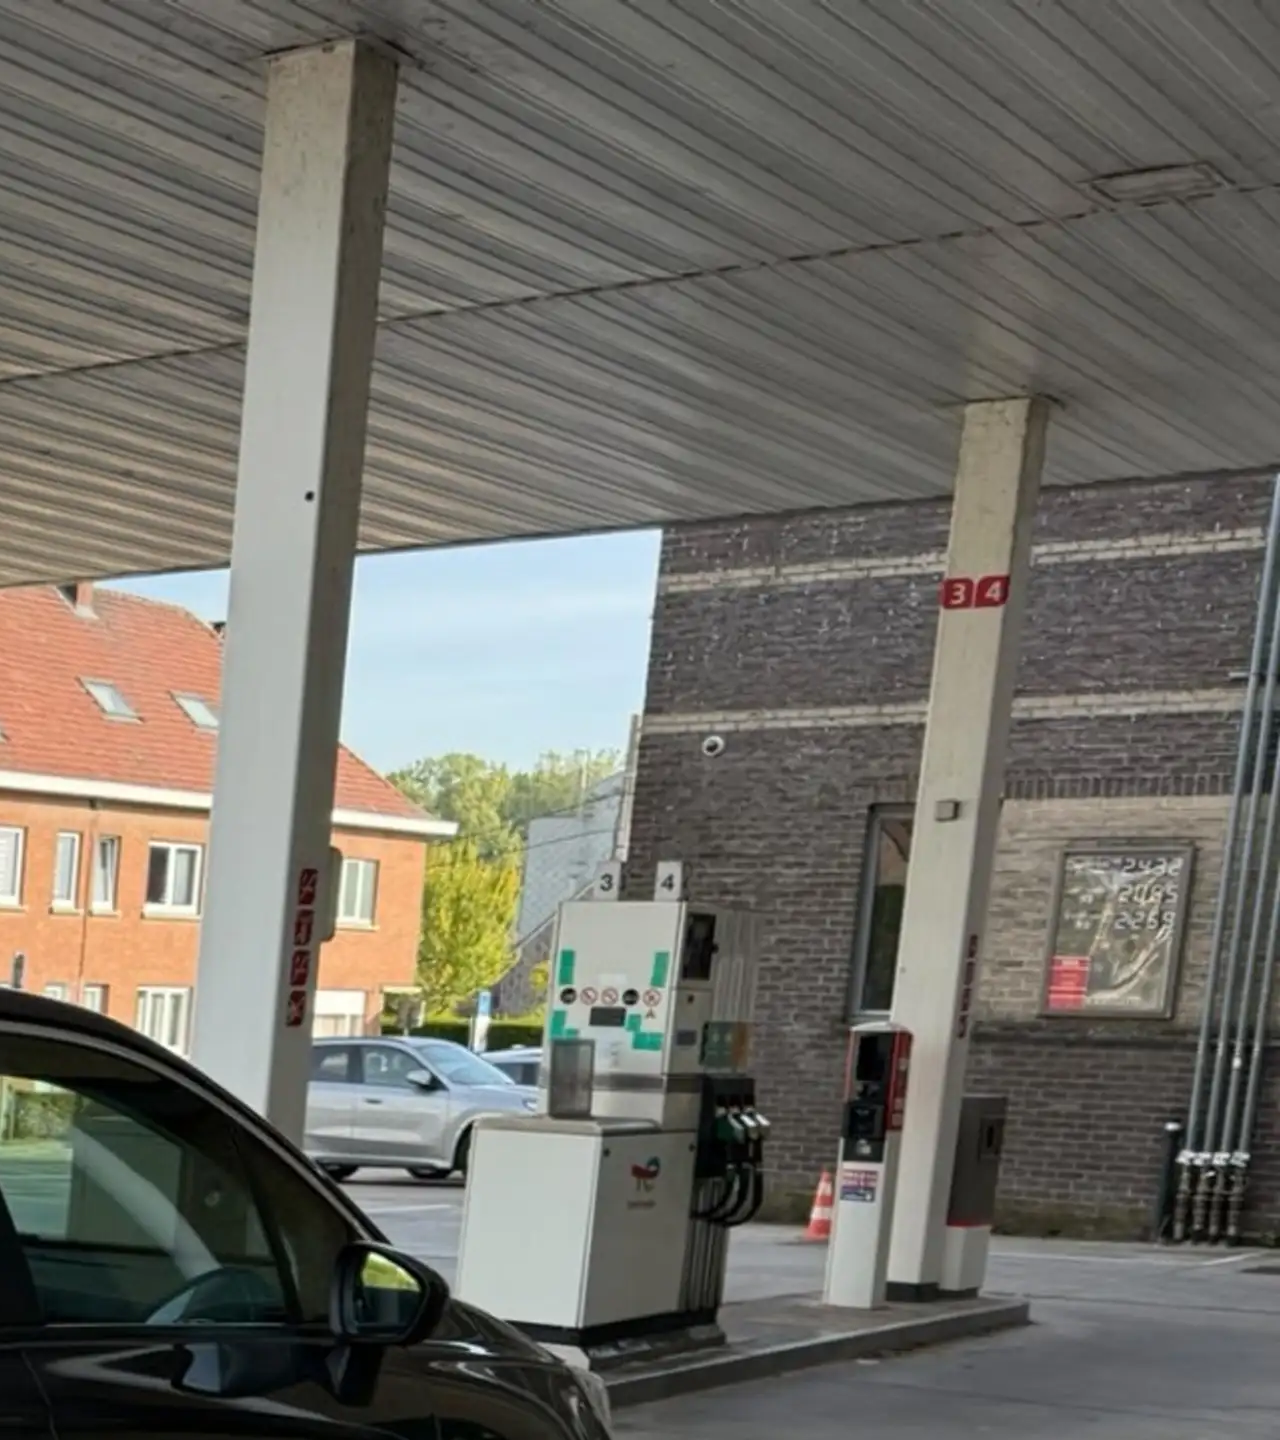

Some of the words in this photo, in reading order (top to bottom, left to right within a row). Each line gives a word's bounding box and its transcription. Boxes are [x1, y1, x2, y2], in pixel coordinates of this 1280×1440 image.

[950, 582, 967, 605] 3
[984, 580, 1002, 602] 4
[599, 872, 614, 893] 3
[660, 873, 675, 892] 4
